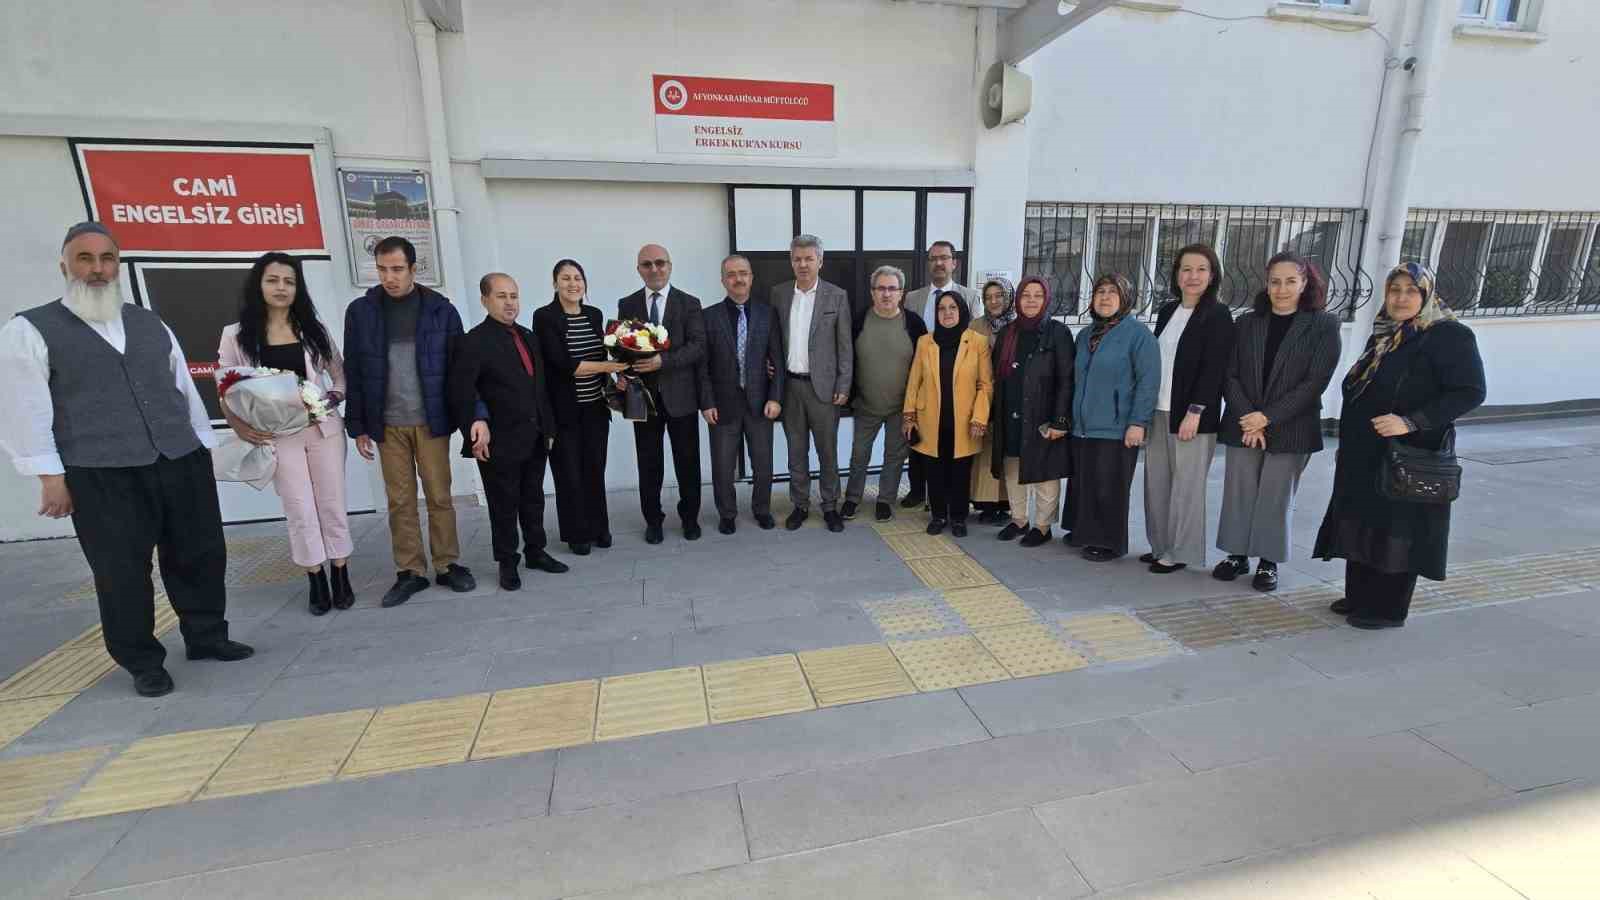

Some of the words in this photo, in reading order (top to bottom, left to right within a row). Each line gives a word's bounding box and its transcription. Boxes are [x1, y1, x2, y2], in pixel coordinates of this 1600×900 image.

[694, 125, 744, 136] ENGELSİZ
[695, 138, 731, 148] ERKEK
[769, 140, 802, 150] KURSU
[172, 175, 237, 197] CAMİ
[112, 203, 232, 225] ENGELSİZ
[237, 203, 305, 228] GİRİŞİ
